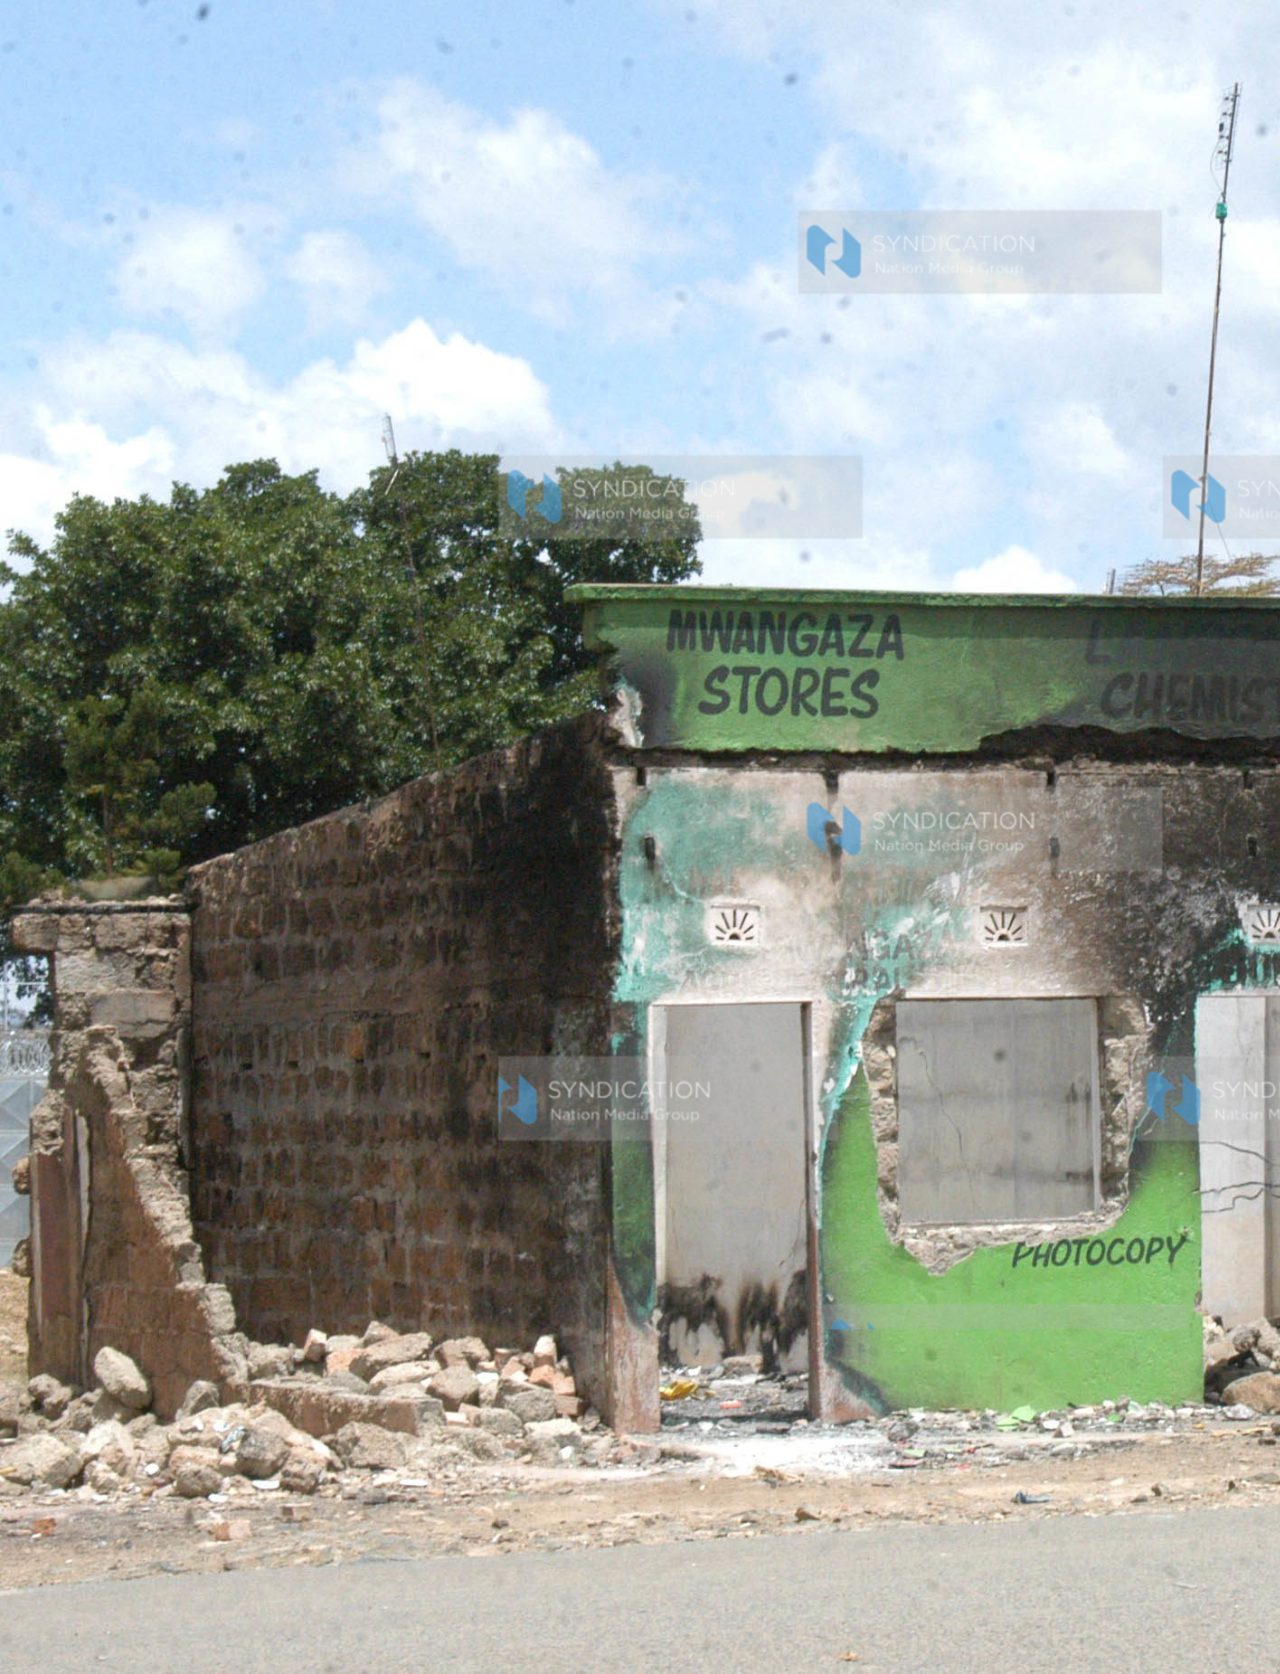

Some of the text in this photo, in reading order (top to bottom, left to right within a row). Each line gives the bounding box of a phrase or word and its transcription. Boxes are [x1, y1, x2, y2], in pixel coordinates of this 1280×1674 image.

[667, 608, 904, 661] MWANGAZA
[698, 665, 881, 719] STORES
[1012, 1235, 1188, 1268] PHOTOCOPY
